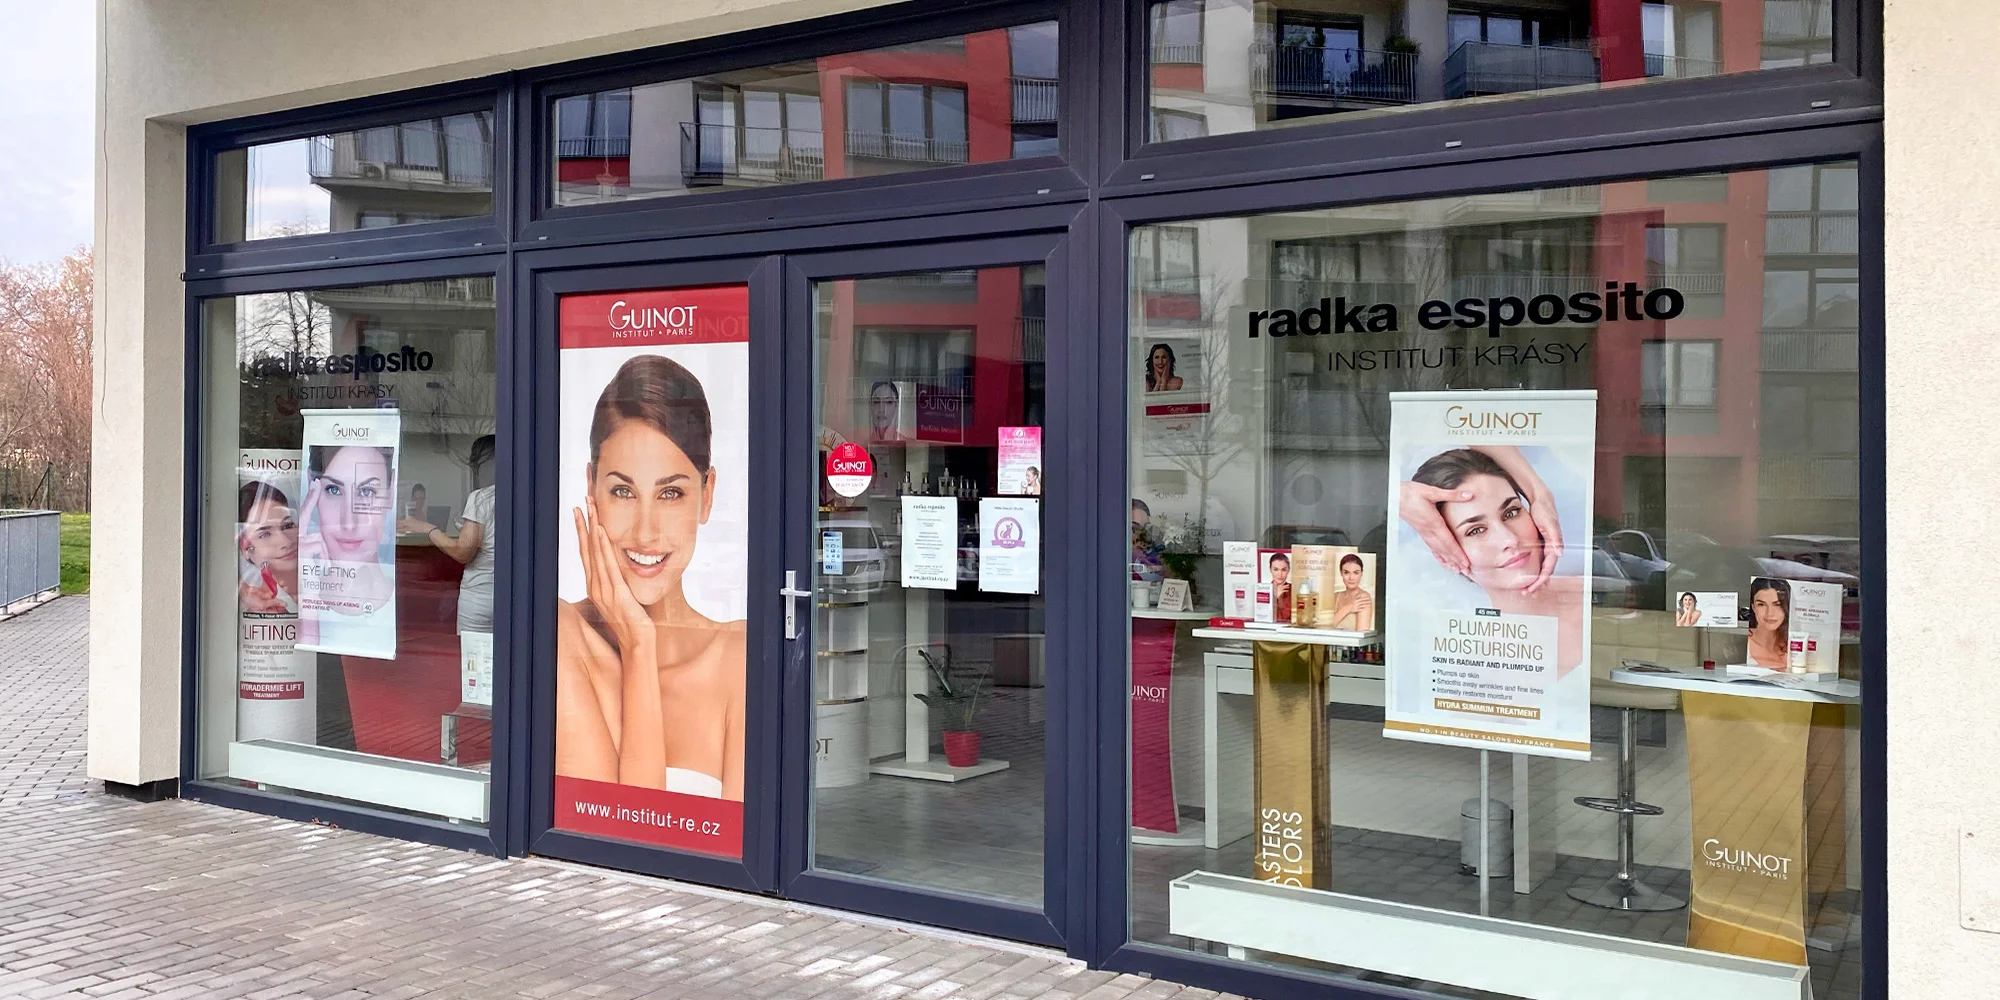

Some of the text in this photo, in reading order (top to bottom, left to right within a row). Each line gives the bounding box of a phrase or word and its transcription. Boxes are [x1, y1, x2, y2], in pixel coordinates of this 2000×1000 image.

[608, 301, 698, 330] GUINOT
[1248, 281, 1685, 339] radka esposito
[612, 327, 694, 338] INSTITUT PARIS
[326, 345, 434, 380] esposito
[1328, 338, 1587, 373] INSTITUT KRÁSY
[287, 385, 345, 400] INSTITUT
[919, 390, 961, 412] GUINOT
[1444, 405, 1543, 429] GUINOT
[332, 423, 370, 438] GUINOT
[241, 454, 301, 471] GUINOT
[832, 459, 867, 471] GUINOT
[302, 564, 356, 579] EYE LIFTING
[302, 578, 344, 592] Treatment
[1448, 619, 1529, 640] PLUMPING
[1434, 636, 1543, 661] MOISTURISING
[1431, 656, 1545, 673] SKIN IS RADIANT AND PLUMPED UP
[1437, 669, 1480, 679] Plumps up skin
[285, 683, 302, 692] LIFT
[1462, 681, 1478, 689] away
[1479, 683, 1504, 691] wrinkles
[1505, 684, 1516, 692] and
[1517, 685, 1528, 693] fine
[1462, 690, 1486, 698] restores
[1437, 700, 1538, 718] HYDRA SUMMUM TREATMENT
[1450, 730, 1479, 739] BEAUTY
[1482, 734, 1511, 743] SALONS
[575, 800, 721, 836] www.institut-re.cz
[1701, 838, 1792, 874] GUINOT
[1706, 860, 1788, 880] INSTITUT PARIS
